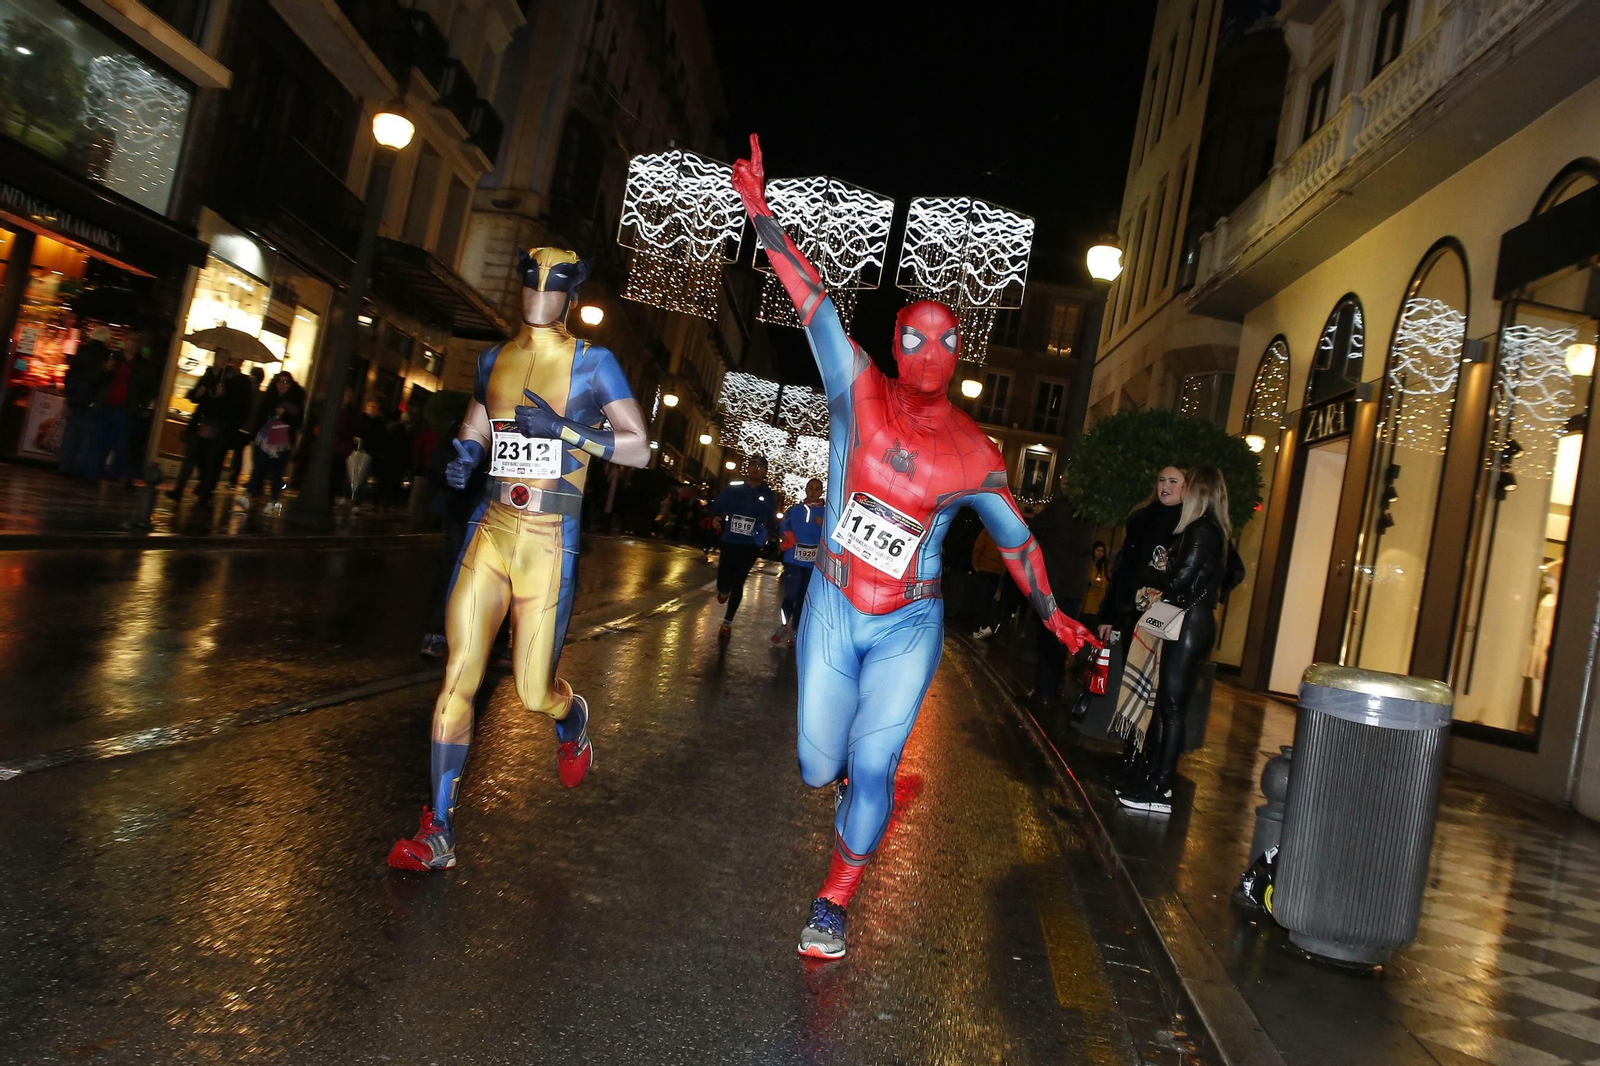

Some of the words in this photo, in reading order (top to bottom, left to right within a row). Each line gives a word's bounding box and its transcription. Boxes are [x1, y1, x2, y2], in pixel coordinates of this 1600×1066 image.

[1304, 401, 1345, 442] ZARA
[497, 441, 550, 461] 2312
[733, 521, 752, 531] 1919
[851, 515, 906, 557] 1156
[1146, 617, 1164, 628] GUESS
